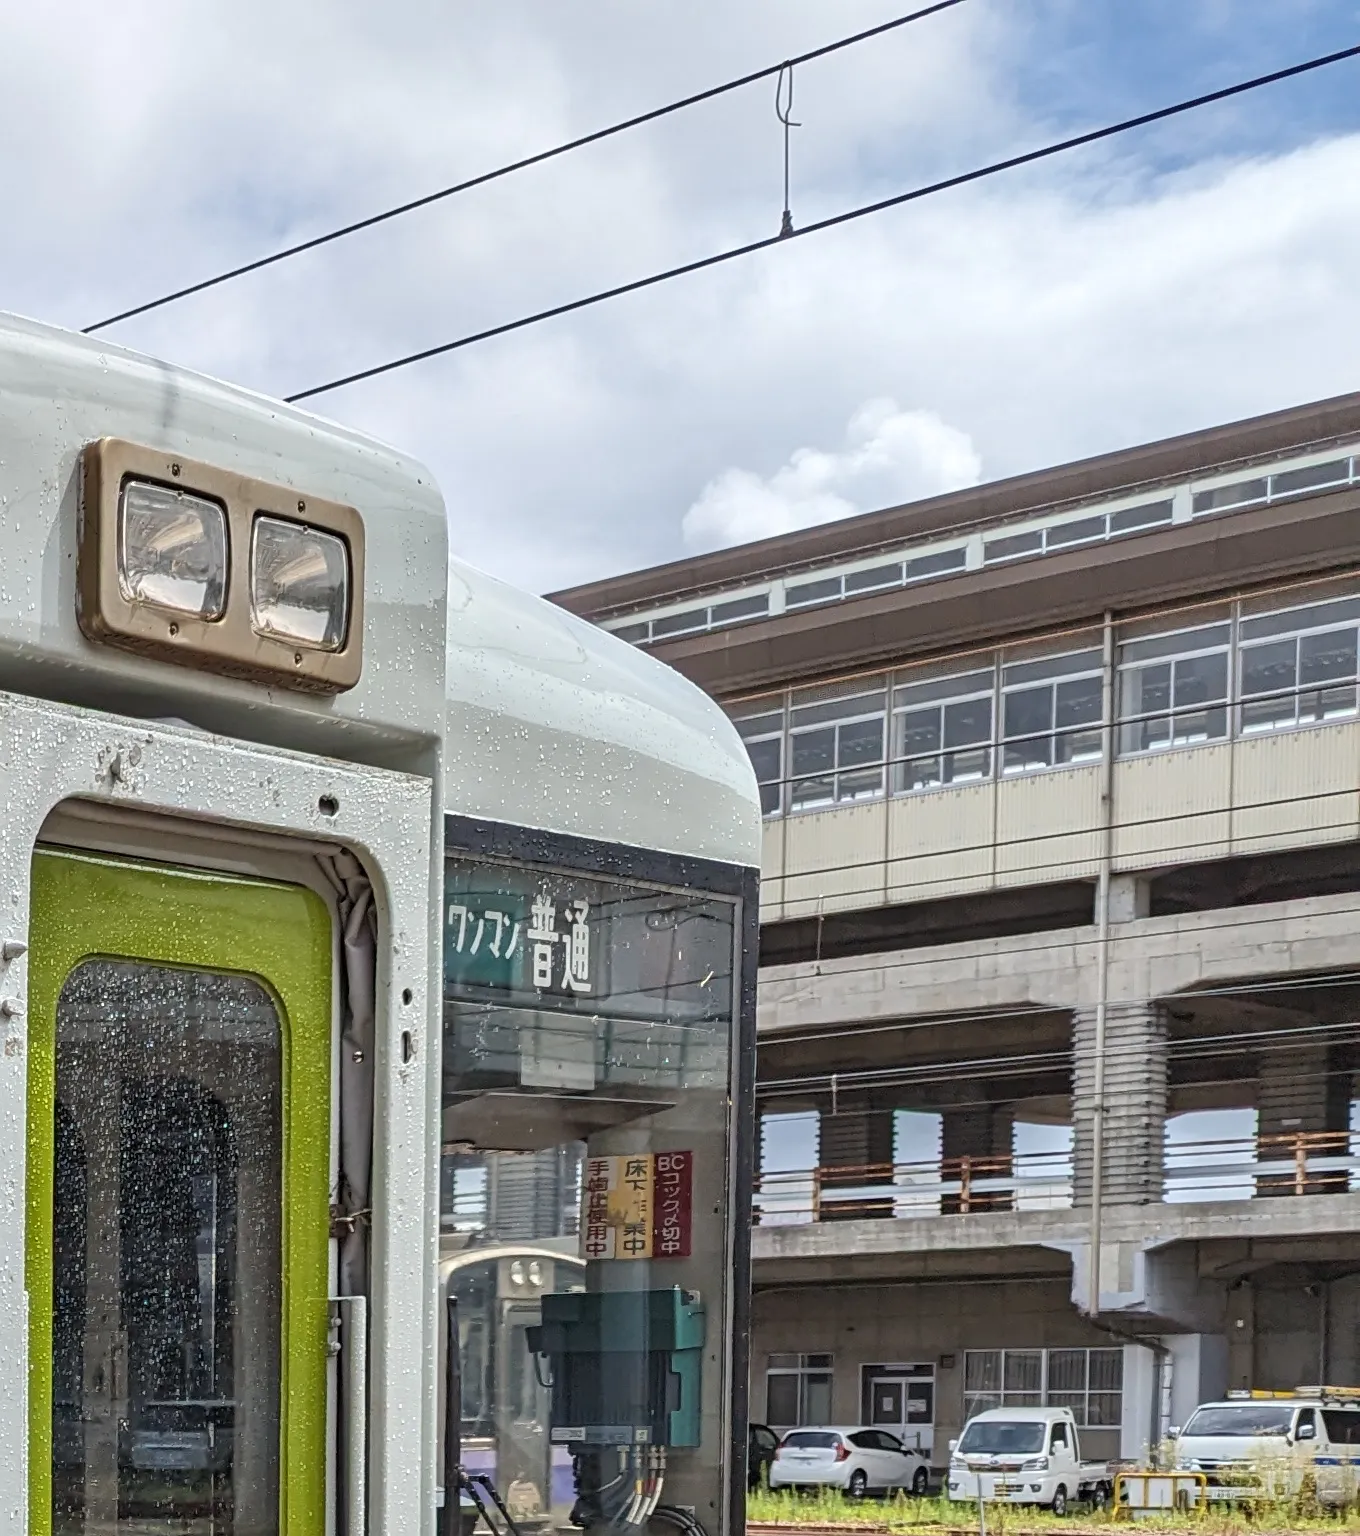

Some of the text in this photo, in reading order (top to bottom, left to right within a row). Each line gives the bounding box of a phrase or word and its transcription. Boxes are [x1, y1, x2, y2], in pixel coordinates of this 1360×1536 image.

[448, 894, 592, 992] ワンマン 普通
[585, 1160, 610, 1257] 手歯止使用中
